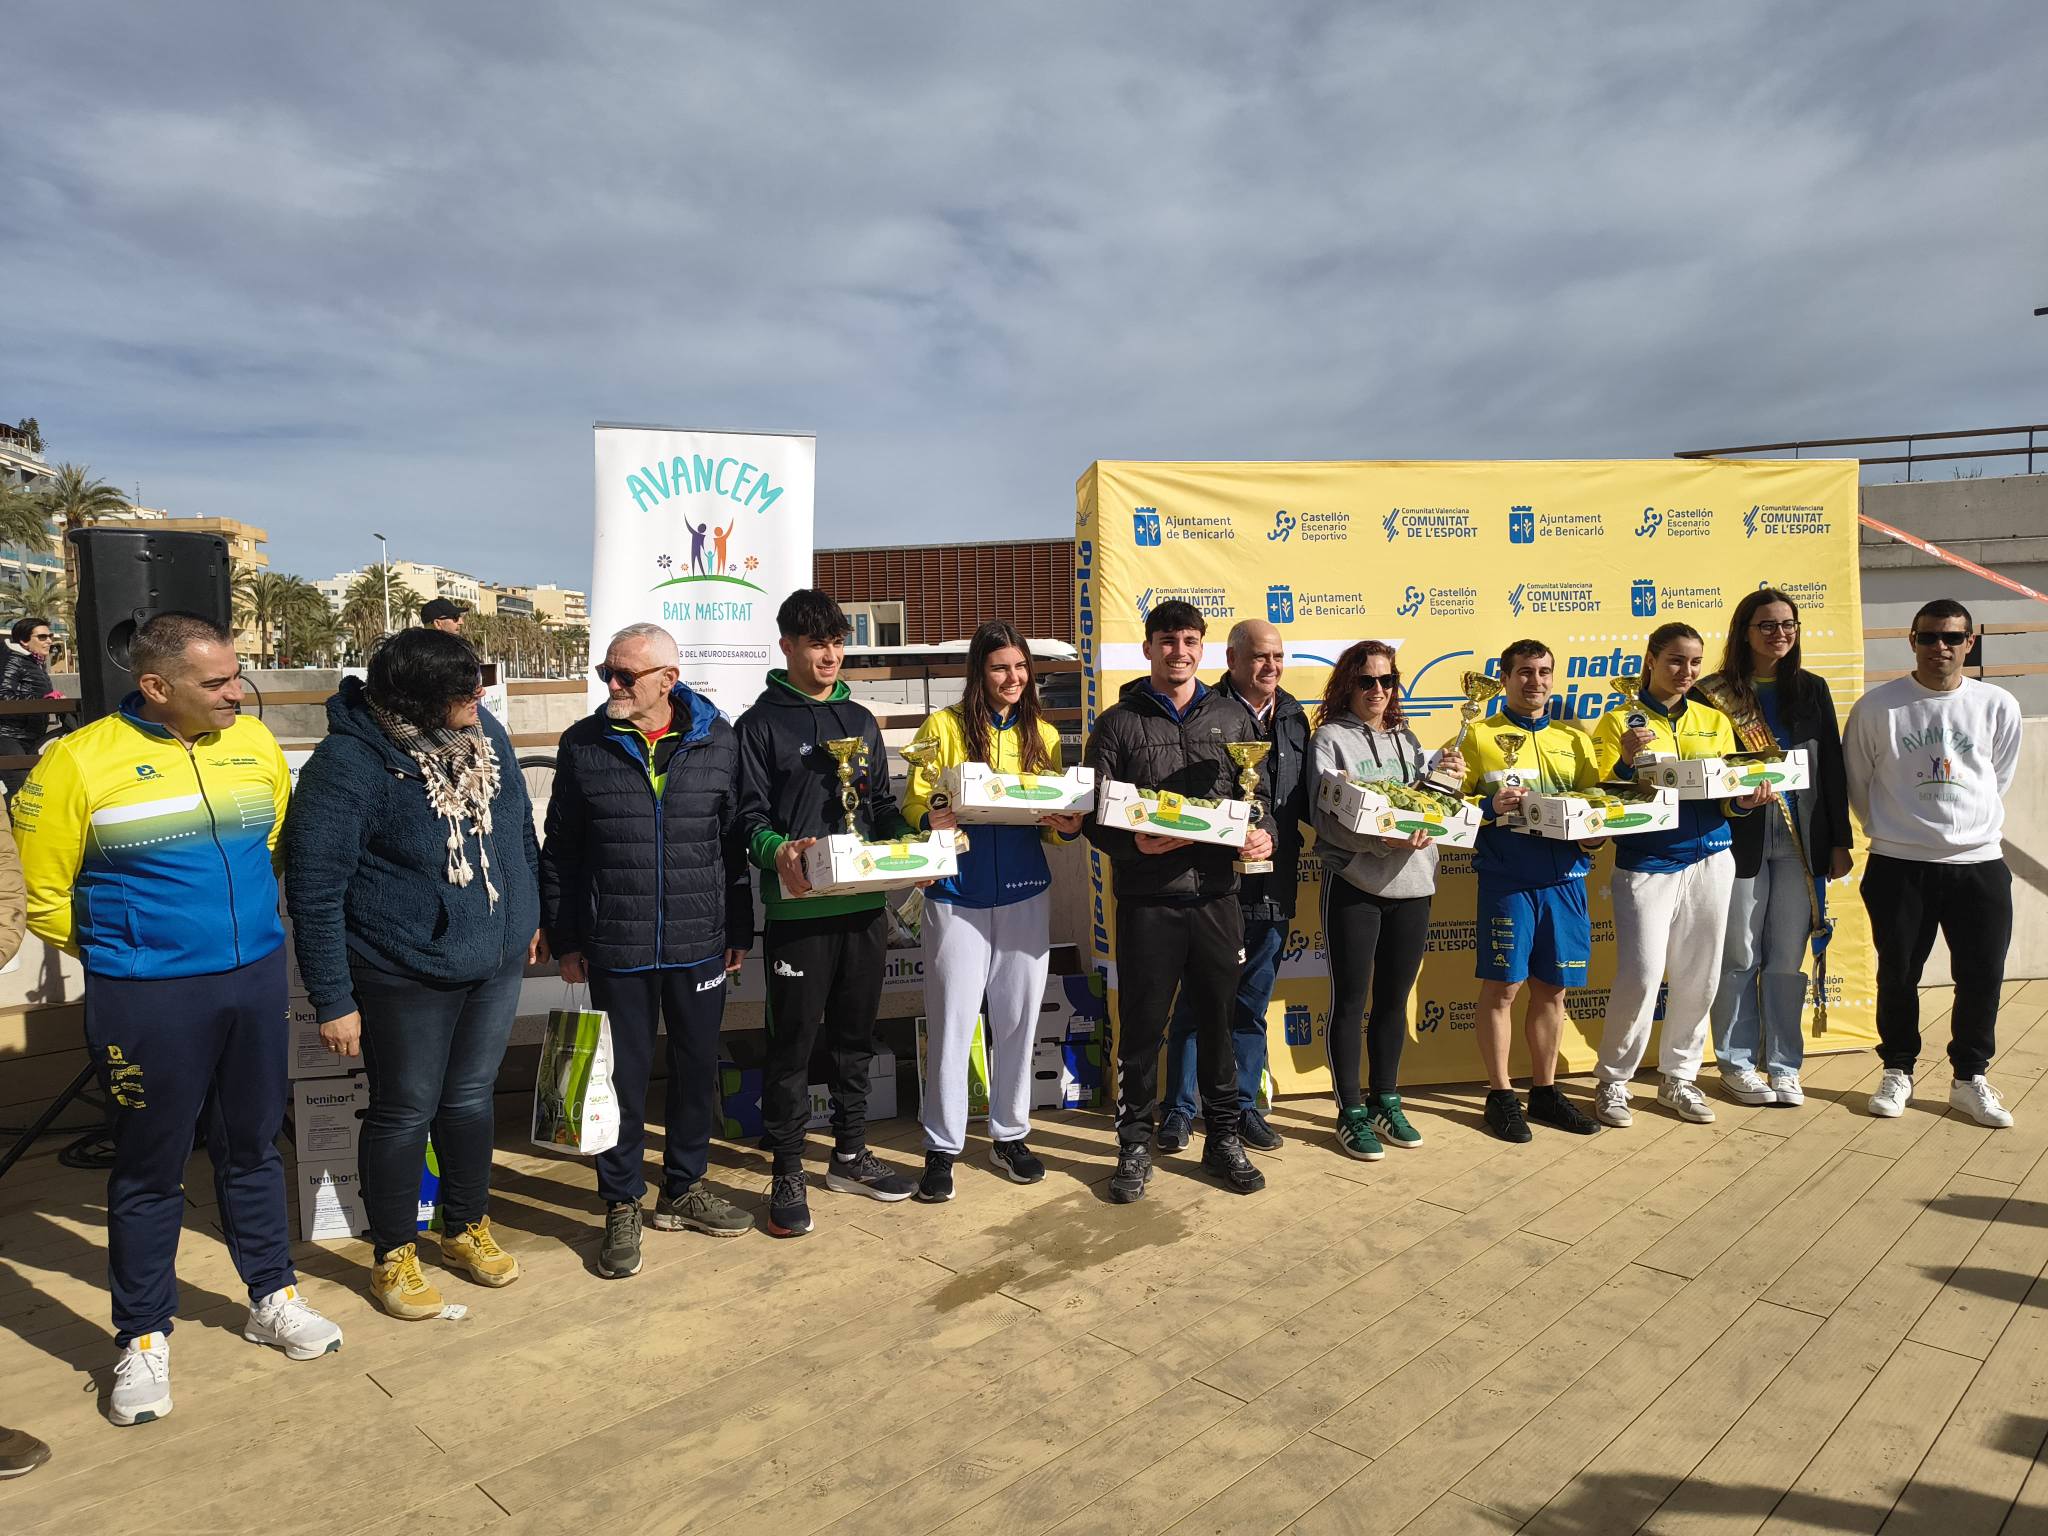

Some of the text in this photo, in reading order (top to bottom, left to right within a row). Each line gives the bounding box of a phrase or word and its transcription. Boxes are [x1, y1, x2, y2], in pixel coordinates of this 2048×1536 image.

[626, 454, 784, 514] AVANCEM
[1301, 512, 1350, 522] Castellón
[1667, 508, 1713, 518] Castellón
[1761, 513, 1823, 523] COMUNITAT
[1166, 516, 1231, 528] Ajuntament
[1402, 516, 1469, 526] COMUNITAT
[1540, 514, 1602, 524] Ajuntament
[1668, 519, 1710, 528] Escenario
[1302, 523, 1347, 531] Escenario
[1540, 525, 1604, 536] de Benicarló
[1765, 524, 1831, 534] DE L'ESPORT
[1167, 528, 1235, 539] de Benicarló
[1302, 532, 1347, 542] Deportivo
[1408, 527, 1478, 538] DE L'ESPORT
[1668, 529, 1710, 538] Deportivo
[1781, 582, 1827, 591] Castellón
[1429, 588, 1477, 597] Castellón
[1527, 591, 1592, 601] COMUNITAT
[1661, 587, 1720, 598] Ajuntament
[1299, 593, 1363, 605] Ajuntament
[1430, 598, 1474, 606] Escenario
[1662, 598, 1723, 609] de Benicarló
[664, 602, 752, 621] BAIX MAESTRAT
[1299, 605, 1366, 616] de Benicarló
[1430, 607, 1474, 616] Deportivo
[1533, 601, 1600, 612] DE L'ESPORT
[1201, 607, 1235, 617] SPORT
[1076, 540, 1096, 735] enicarló
[1567, 648, 1643, 678] nata
[1441, 865, 1478, 874] Benica
[1427, 928, 1476, 940] MUNITA
[1590, 932, 1614, 942] carló
[1438, 940, 1476, 951] L'ESPO
[1449, 1002, 1478, 1011] Caste
[1564, 996, 1609, 1009] MUNITA
[1571, 1008, 1606, 1020] L'ESPO
[306, 1093, 355, 1104] benihort
[310, 1173, 358, 1185] benihort
